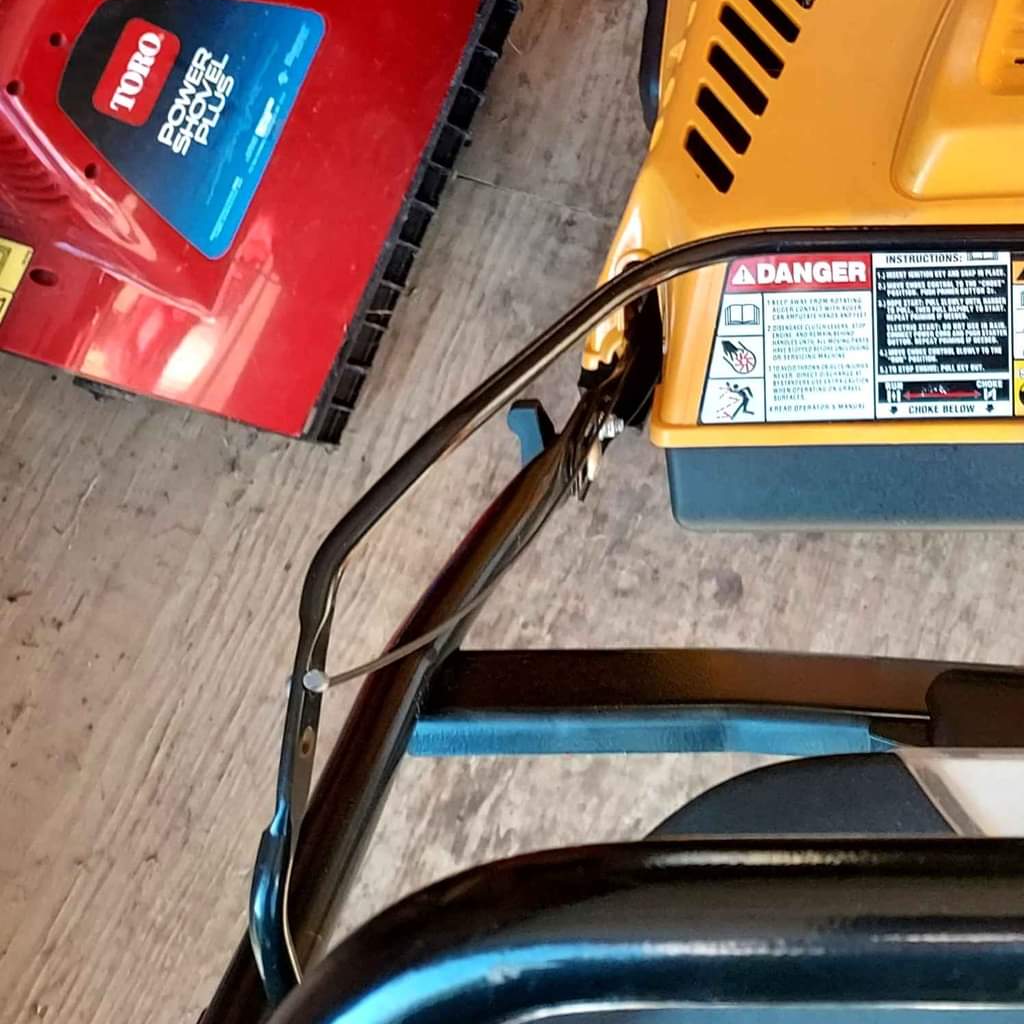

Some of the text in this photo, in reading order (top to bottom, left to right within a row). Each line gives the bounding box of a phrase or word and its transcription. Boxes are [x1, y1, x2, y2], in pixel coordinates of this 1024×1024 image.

[110, 31, 165, 115] TORO
[157, 46, 212, 146] POWER
[172, 54, 230, 156] SHOVEL
[196, 74, 235, 146] PLUS
[757, 261, 866, 284] DANGER
[886, 255, 963, 263] INSTRUCTIONS:
[976, 380, 1003, 389] CHOKE
[909, 405, 975, 414] CHOKE BELOW
